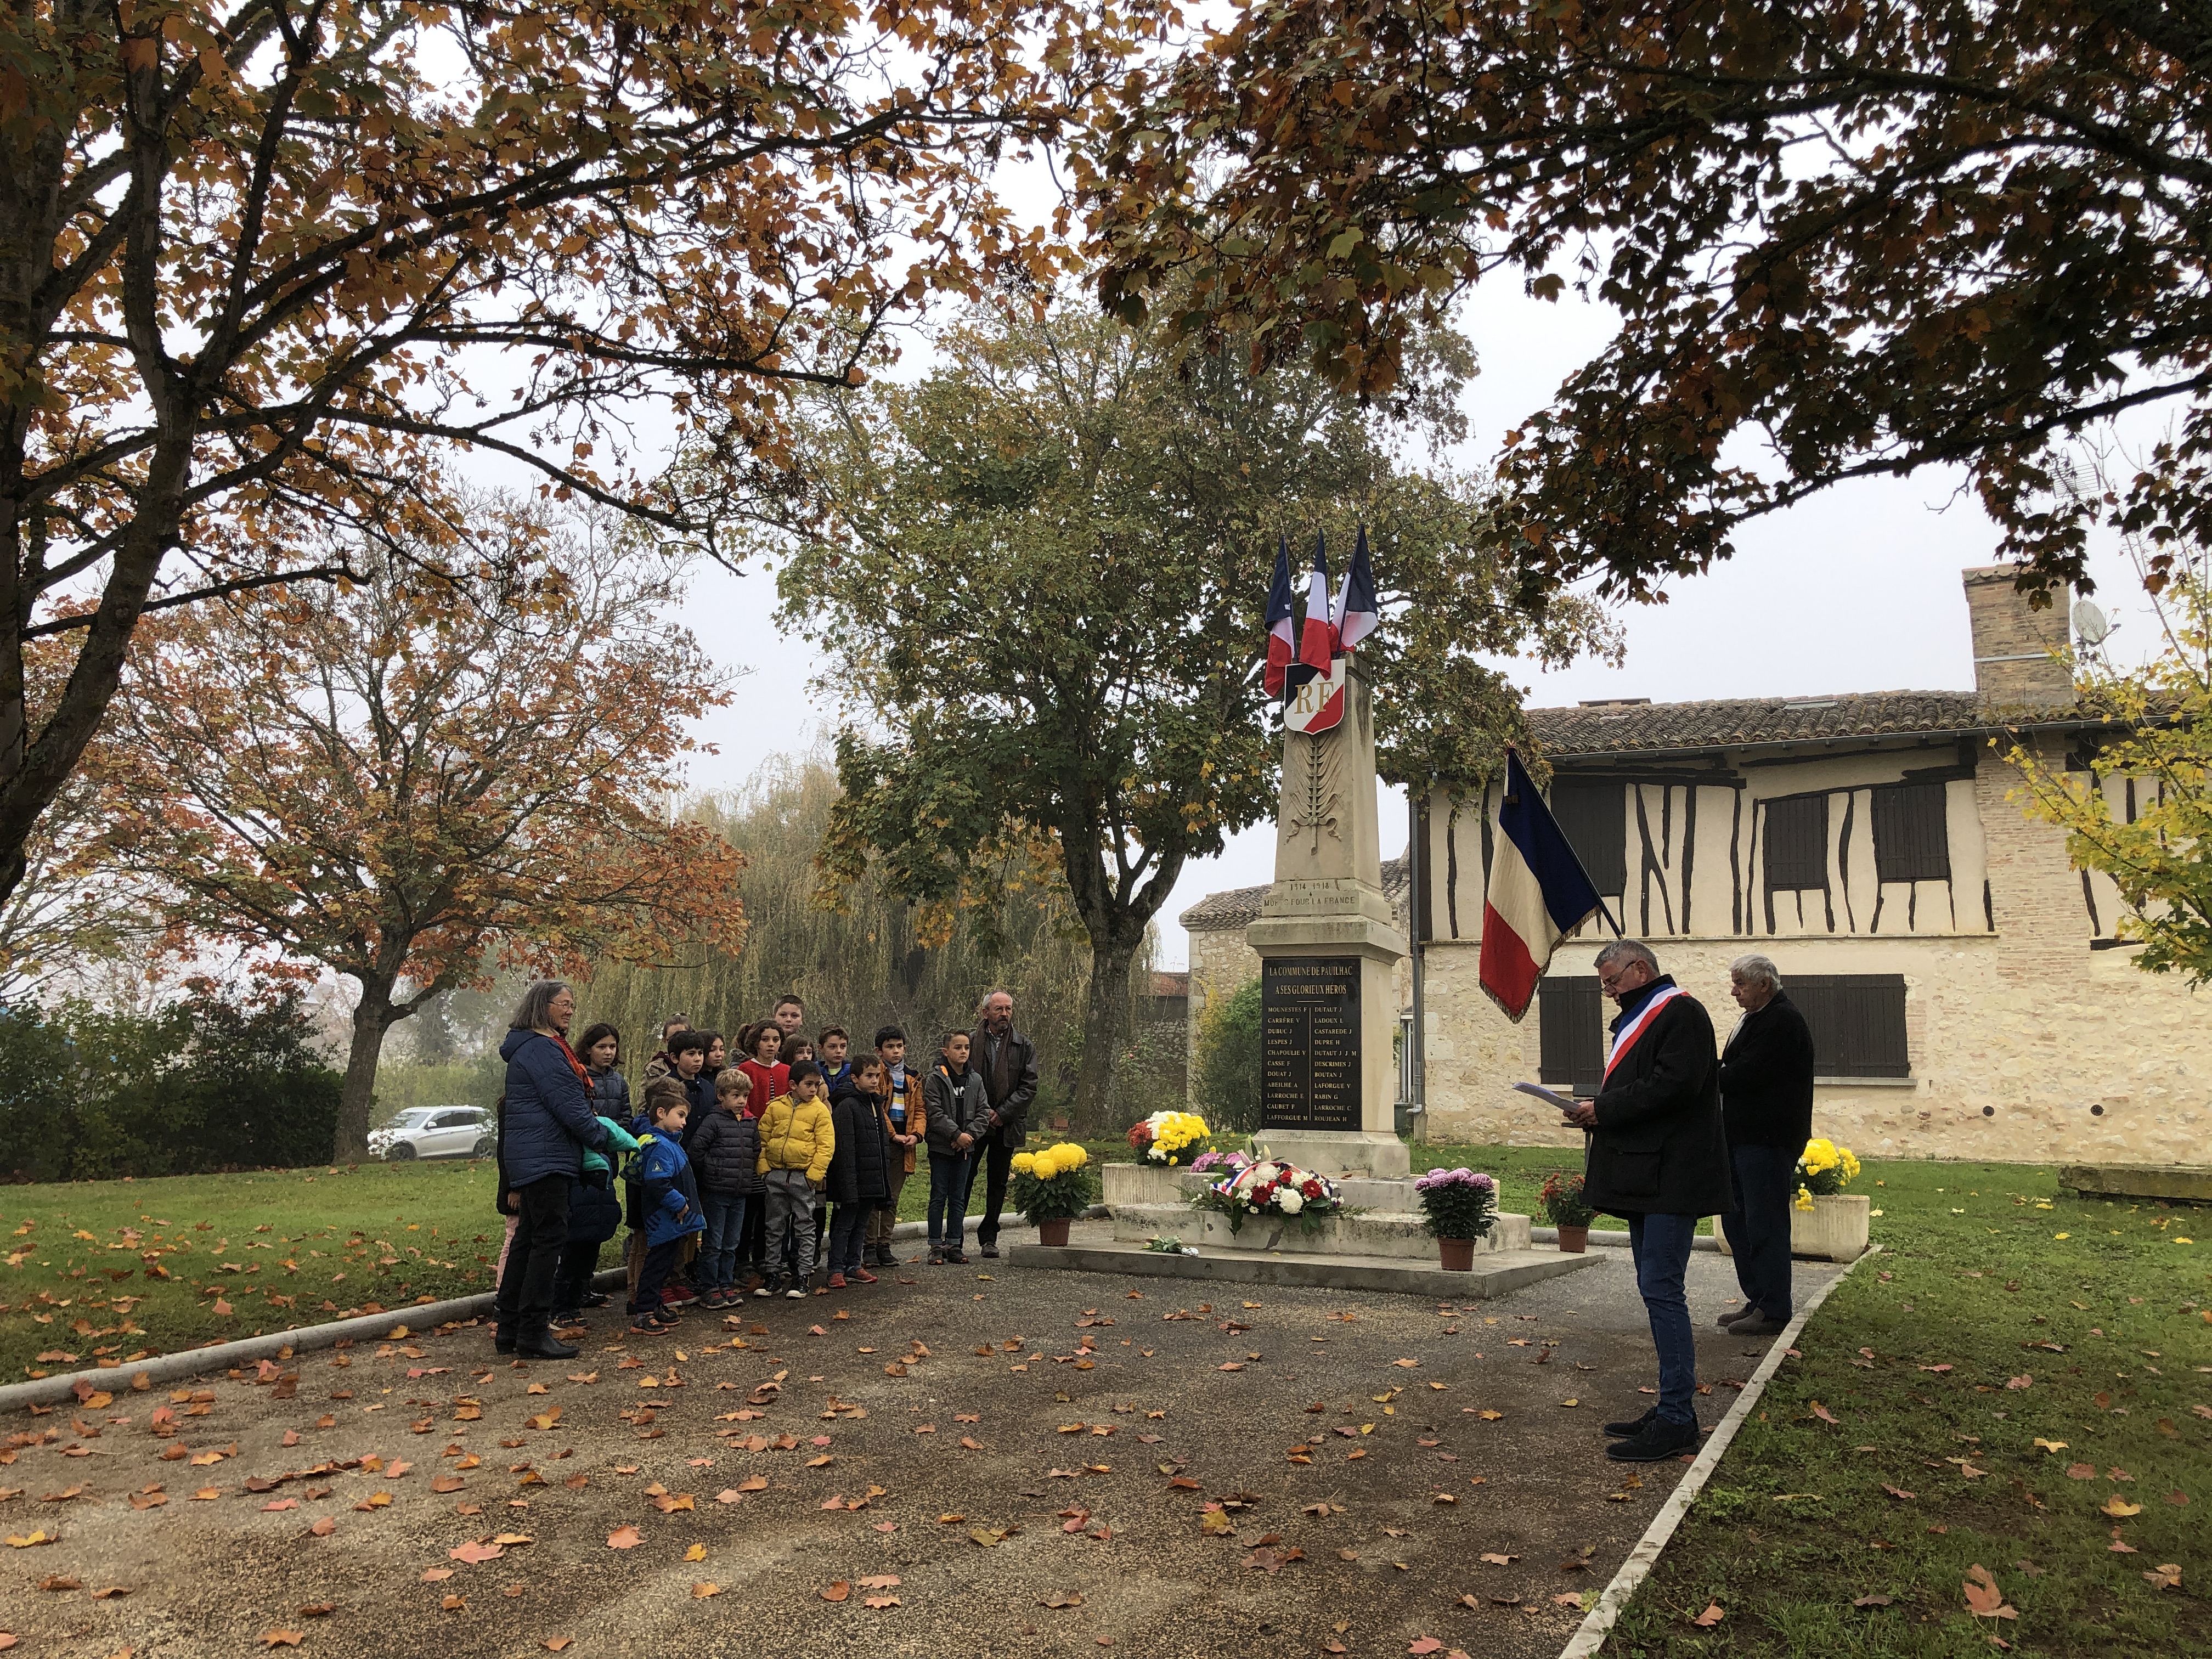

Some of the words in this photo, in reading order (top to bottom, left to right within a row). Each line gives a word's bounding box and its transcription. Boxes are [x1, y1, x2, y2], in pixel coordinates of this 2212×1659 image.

[1294, 682, 1334, 714] RF
[1264, 899, 1289, 907] MORS
[1324, 896, 1355, 905] FRANCE
[1269, 967, 1277, 977] LA
[1278, 966, 1311, 977] COMMUNE
[1311, 966, 1320, 976] DE
[1321, 966, 1352, 976] PAUILHAC
[1280, 985, 1291, 995] SES
[1292, 985, 1324, 995] GLORIEUX
[1325, 982, 1346, 994] HÉROS
[953, 1086, 965, 1096] NY
